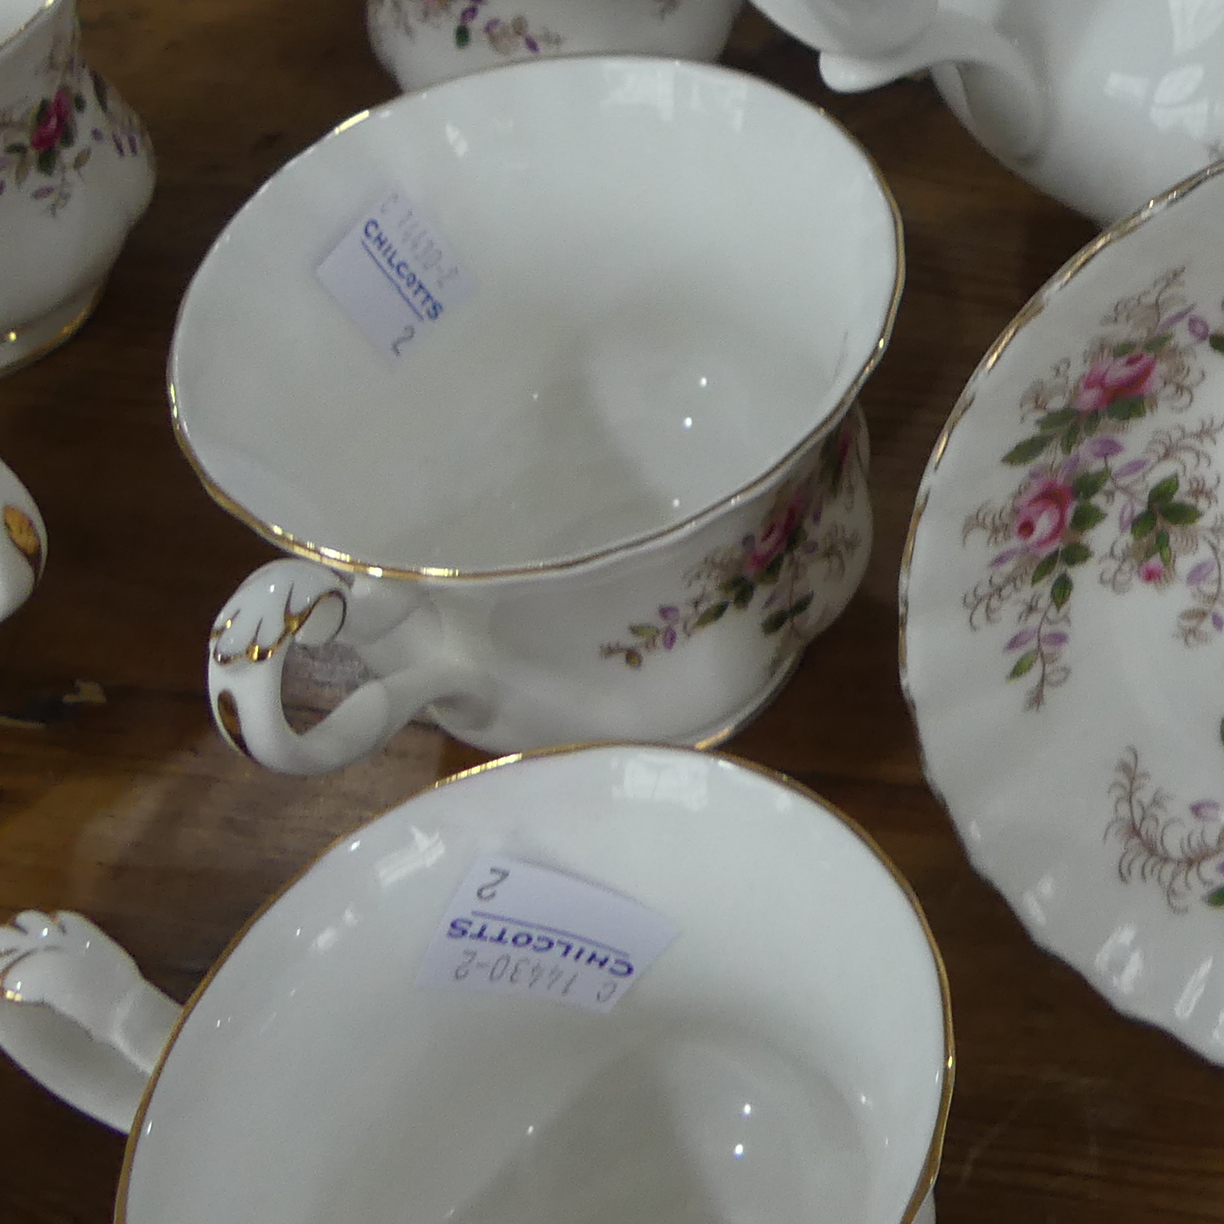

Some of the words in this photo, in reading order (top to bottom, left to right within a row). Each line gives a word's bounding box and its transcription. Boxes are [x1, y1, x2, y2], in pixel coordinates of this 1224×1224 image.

[363, 218, 444, 321] CHILCOTTS
[391, 325, 416, 357] 2
[477, 867, 510, 901] 2
[447, 917, 634, 978] CHILCOTTS
[454, 949, 579, 996] 14430-2
[597, 981, 617, 1003] C
